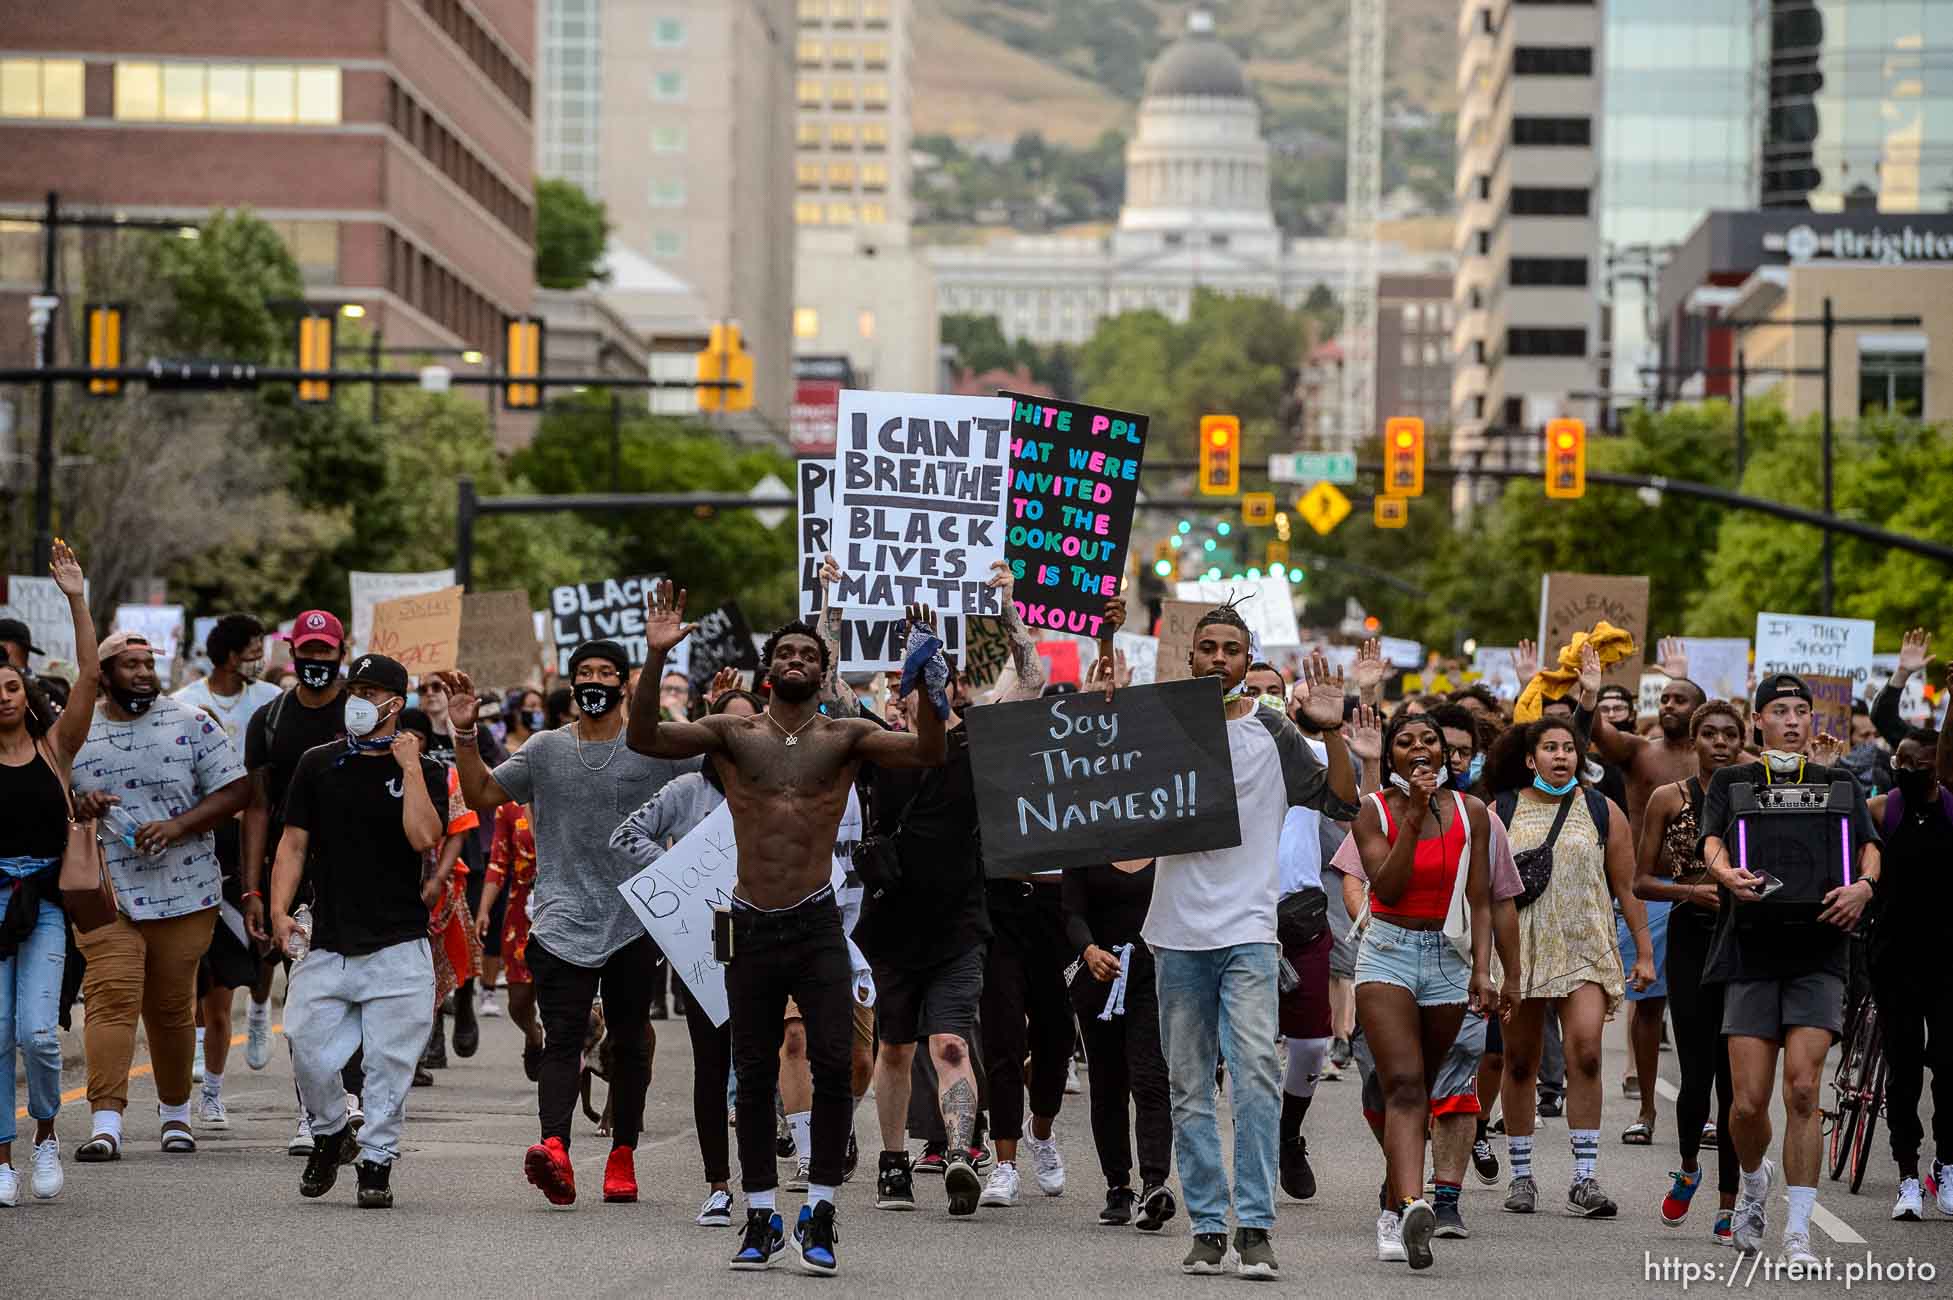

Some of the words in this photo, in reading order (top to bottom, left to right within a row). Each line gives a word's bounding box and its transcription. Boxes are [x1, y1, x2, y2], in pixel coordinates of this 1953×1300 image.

[851, 413, 867, 449] I
[878, 416, 1010, 459] CAN'T
[1010, 400, 1072, 431] HITE
[1091, 415, 1141, 444] PPL
[845, 451, 1003, 500] BREATHE
[1010, 437, 1054, 463] HAT
[1069, 447, 1137, 480] WERE
[1008, 468, 1112, 504] INVITED
[849, 507, 994, 547] BLACK
[1013, 498, 1043, 519] TO
[1062, 505, 1110, 535] THE
[848, 543, 967, 578] LIVES
[1005, 524, 1116, 561] OOKOUT
[553, 577, 663, 615] BLACK
[837, 571, 999, 615] MATTER
[1037, 564, 1061, 586] IS
[1070, 565, 1117, 596] THE
[554, 608, 650, 643] LIVE
[1013, 600, 1104, 637] OKOUT
[1050, 700, 1118, 747] Say
[1030, 748, 1142, 785] Their
[630, 831, 736, 918] Black
